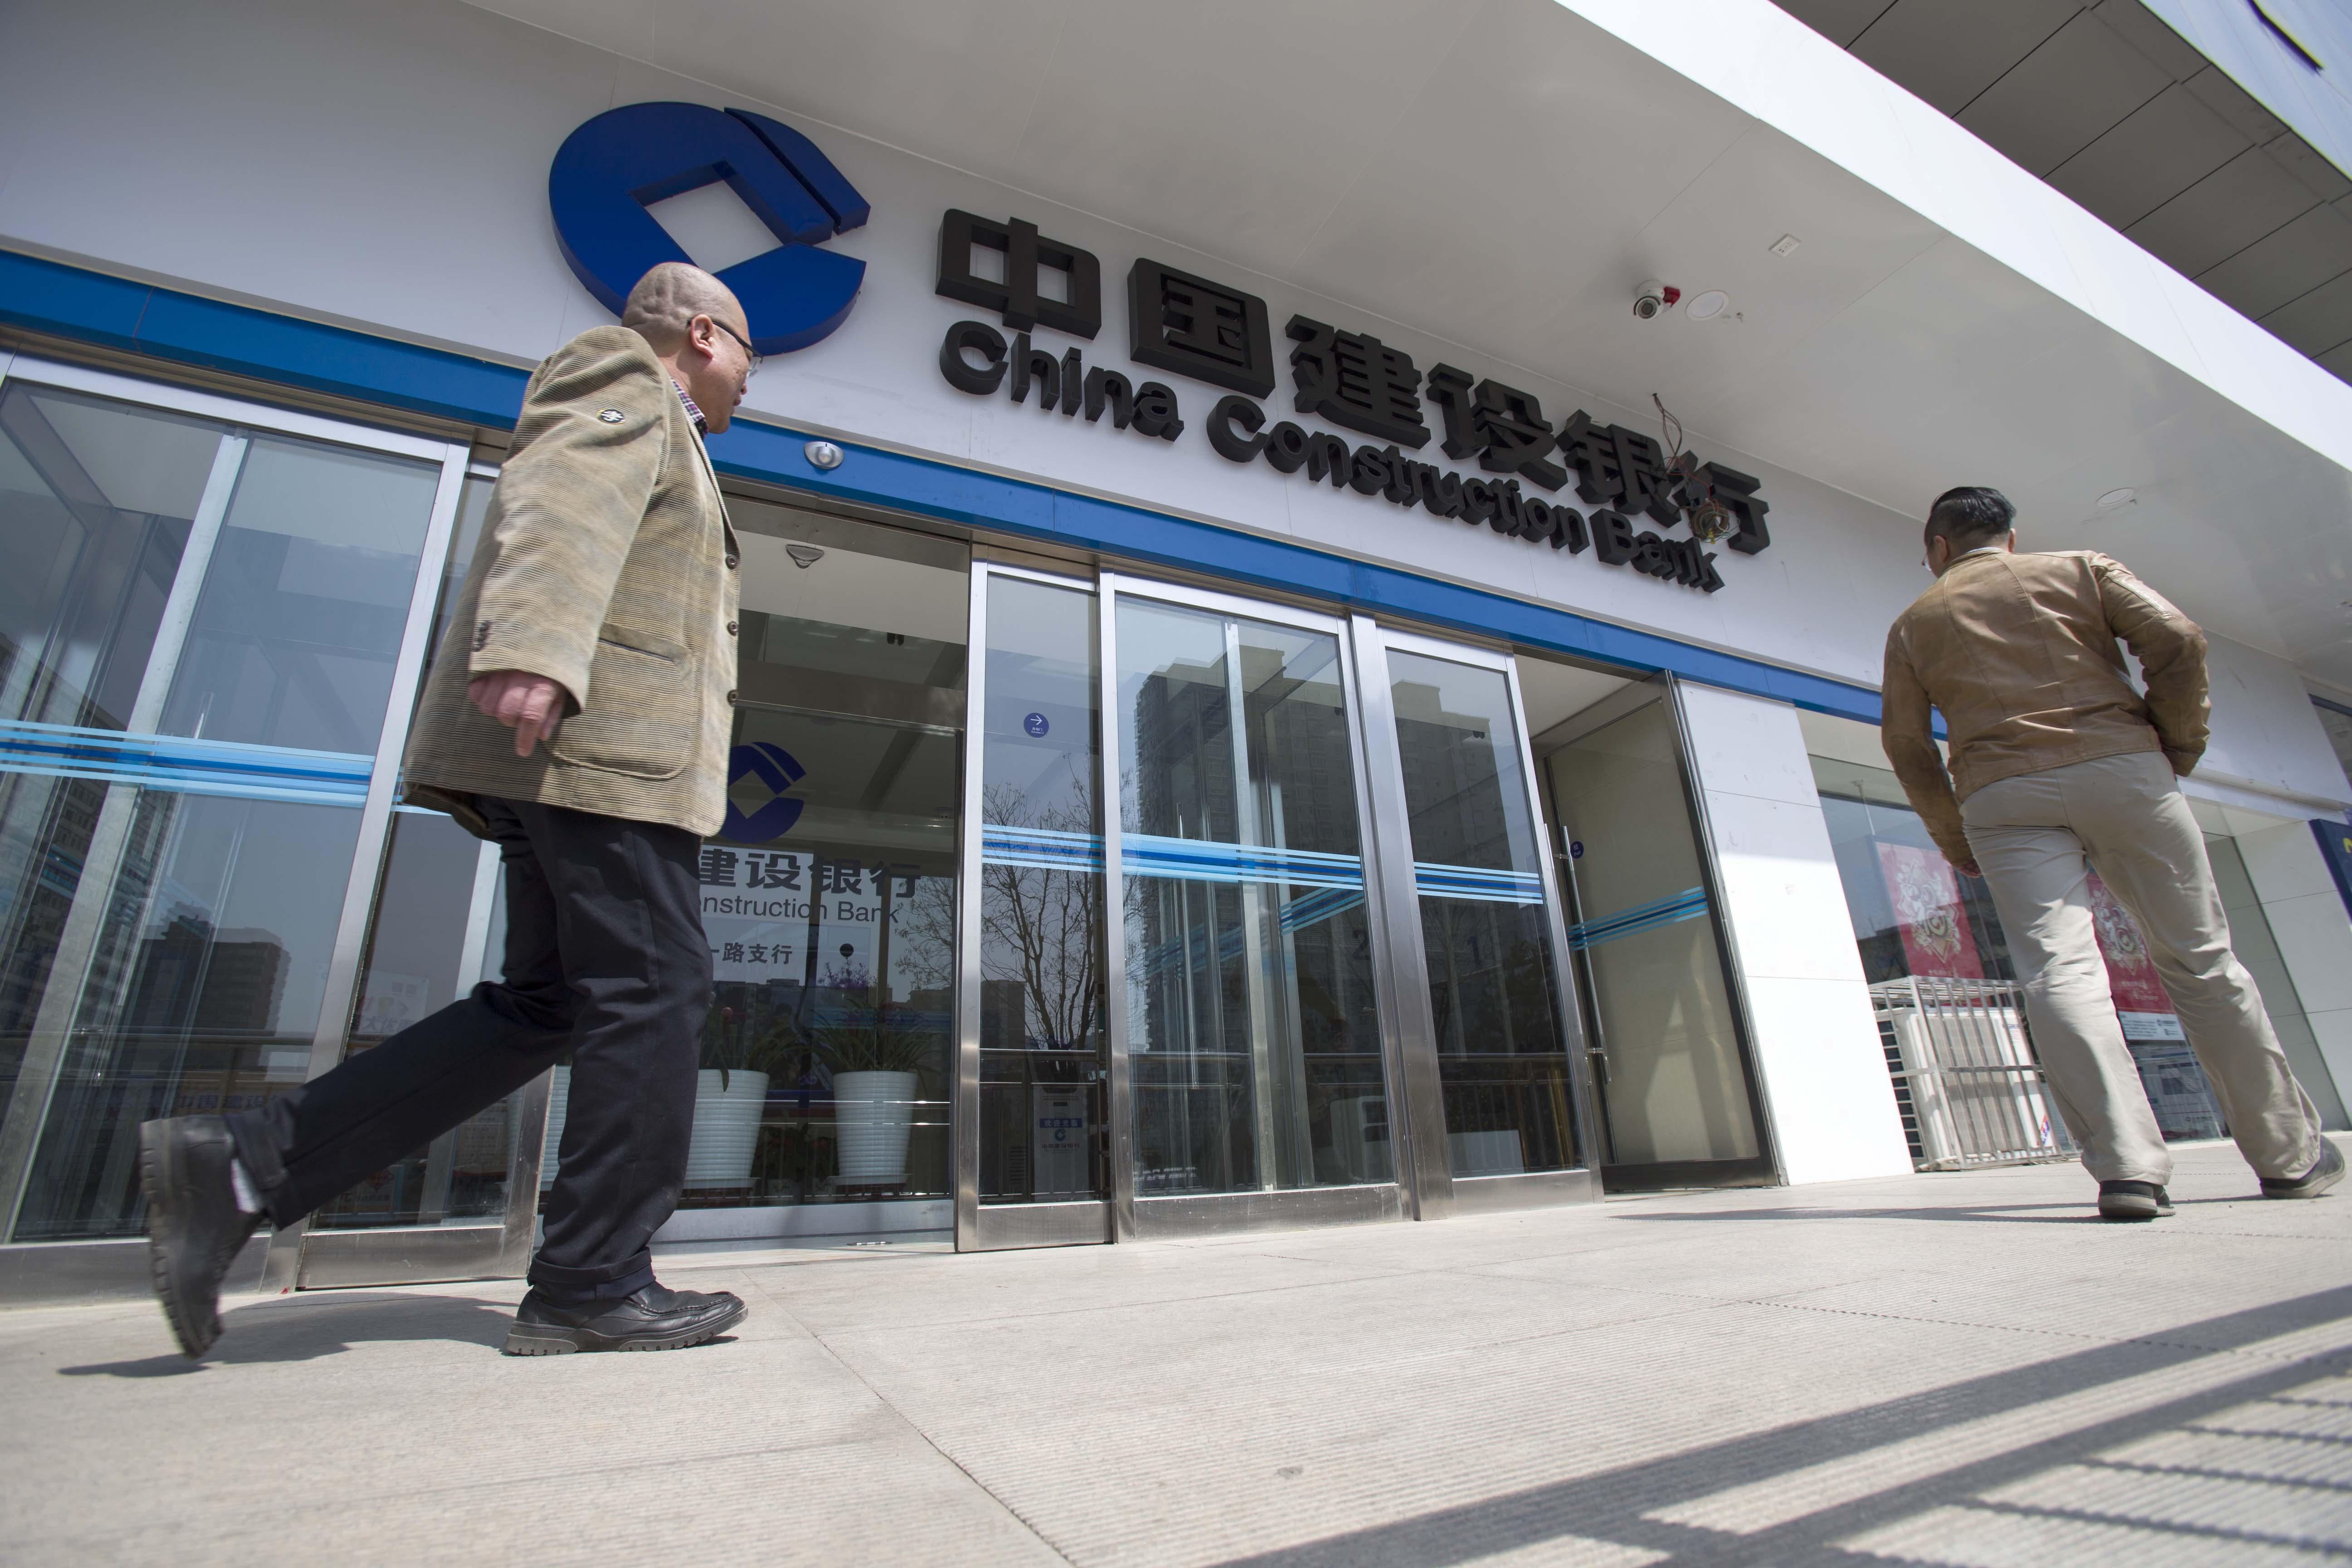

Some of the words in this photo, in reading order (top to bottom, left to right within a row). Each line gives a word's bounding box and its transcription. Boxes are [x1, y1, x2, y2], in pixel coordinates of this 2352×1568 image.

[935, 208, 1770, 555] 中国建设银行
[939, 320, 1184, 442] China
[1206, 395, 1590, 555] Construction
[1589, 508, 1725, 593] Bank
[700, 895, 827, 920] nstruction
[178, 1094, 278, 1109] 中国建设
